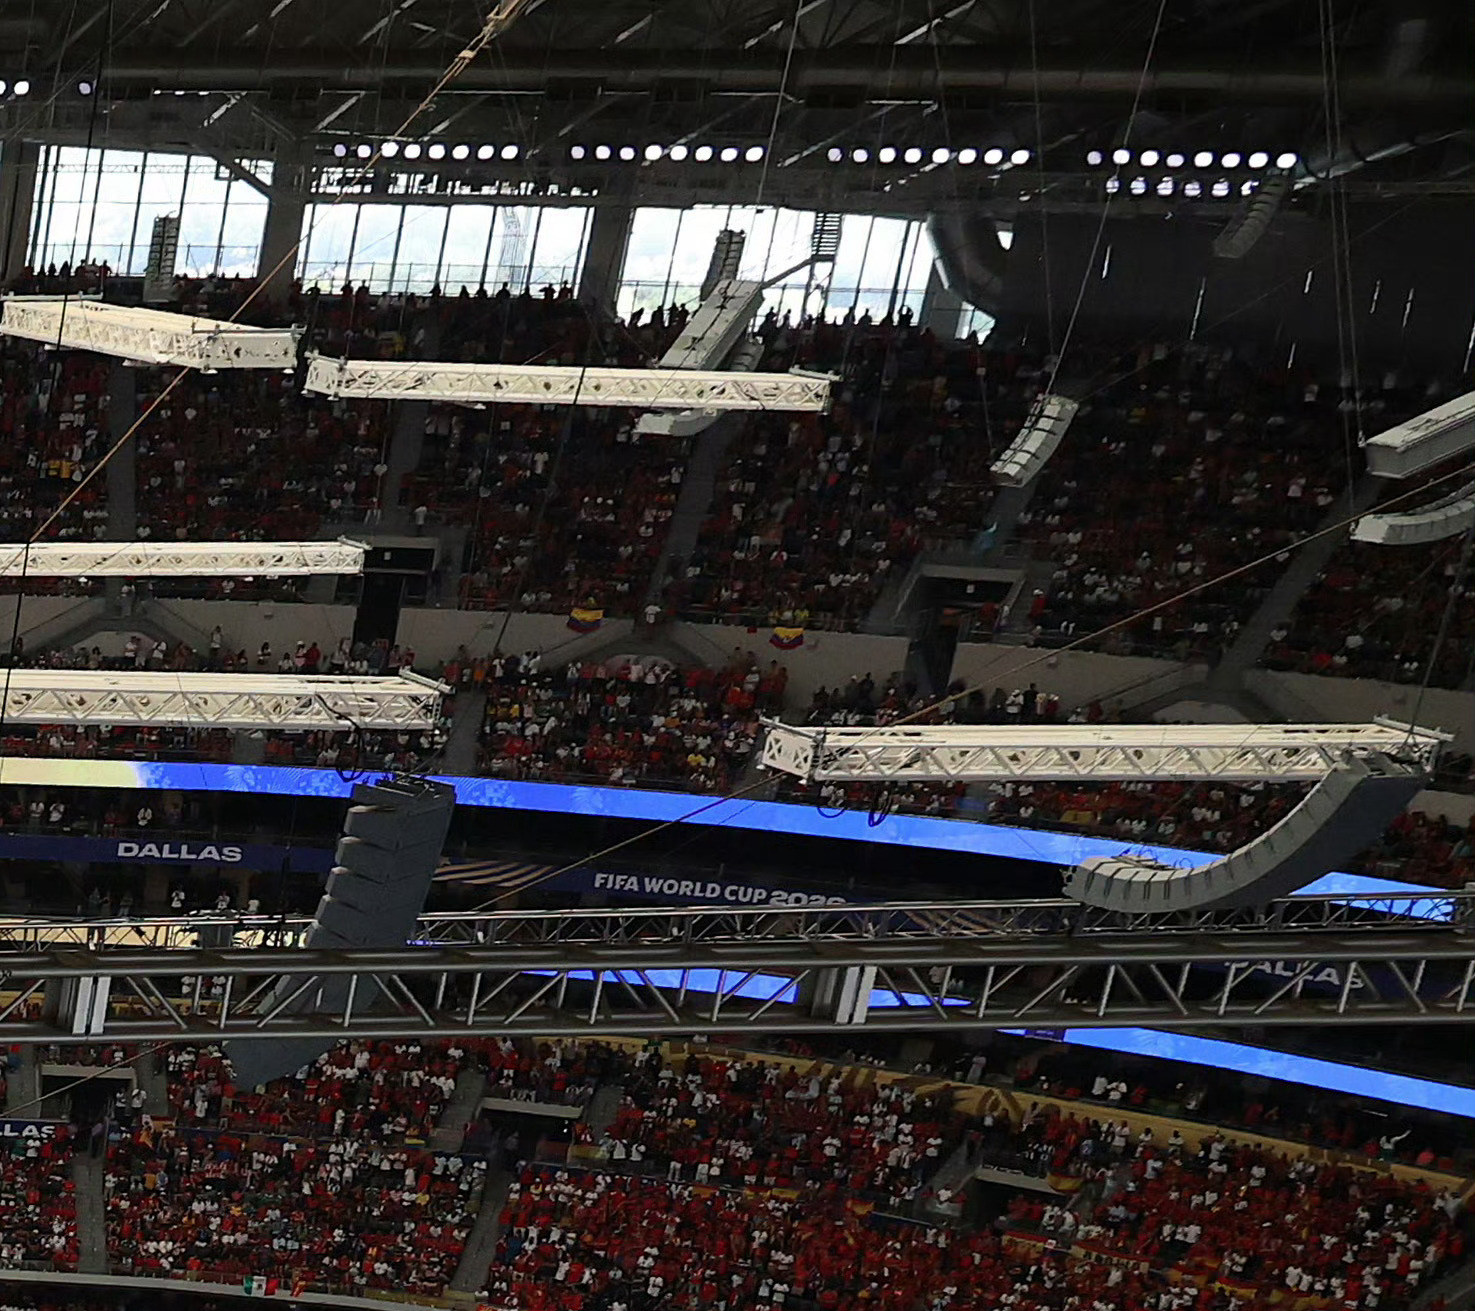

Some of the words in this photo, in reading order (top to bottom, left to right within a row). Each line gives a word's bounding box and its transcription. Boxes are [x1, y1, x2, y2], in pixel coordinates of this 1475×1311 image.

[117, 842, 243, 862] DALLAS
[594, 873, 640, 892] FIFA
[643, 876, 721, 899] WORLD
[724, 885, 767, 904] CUP
